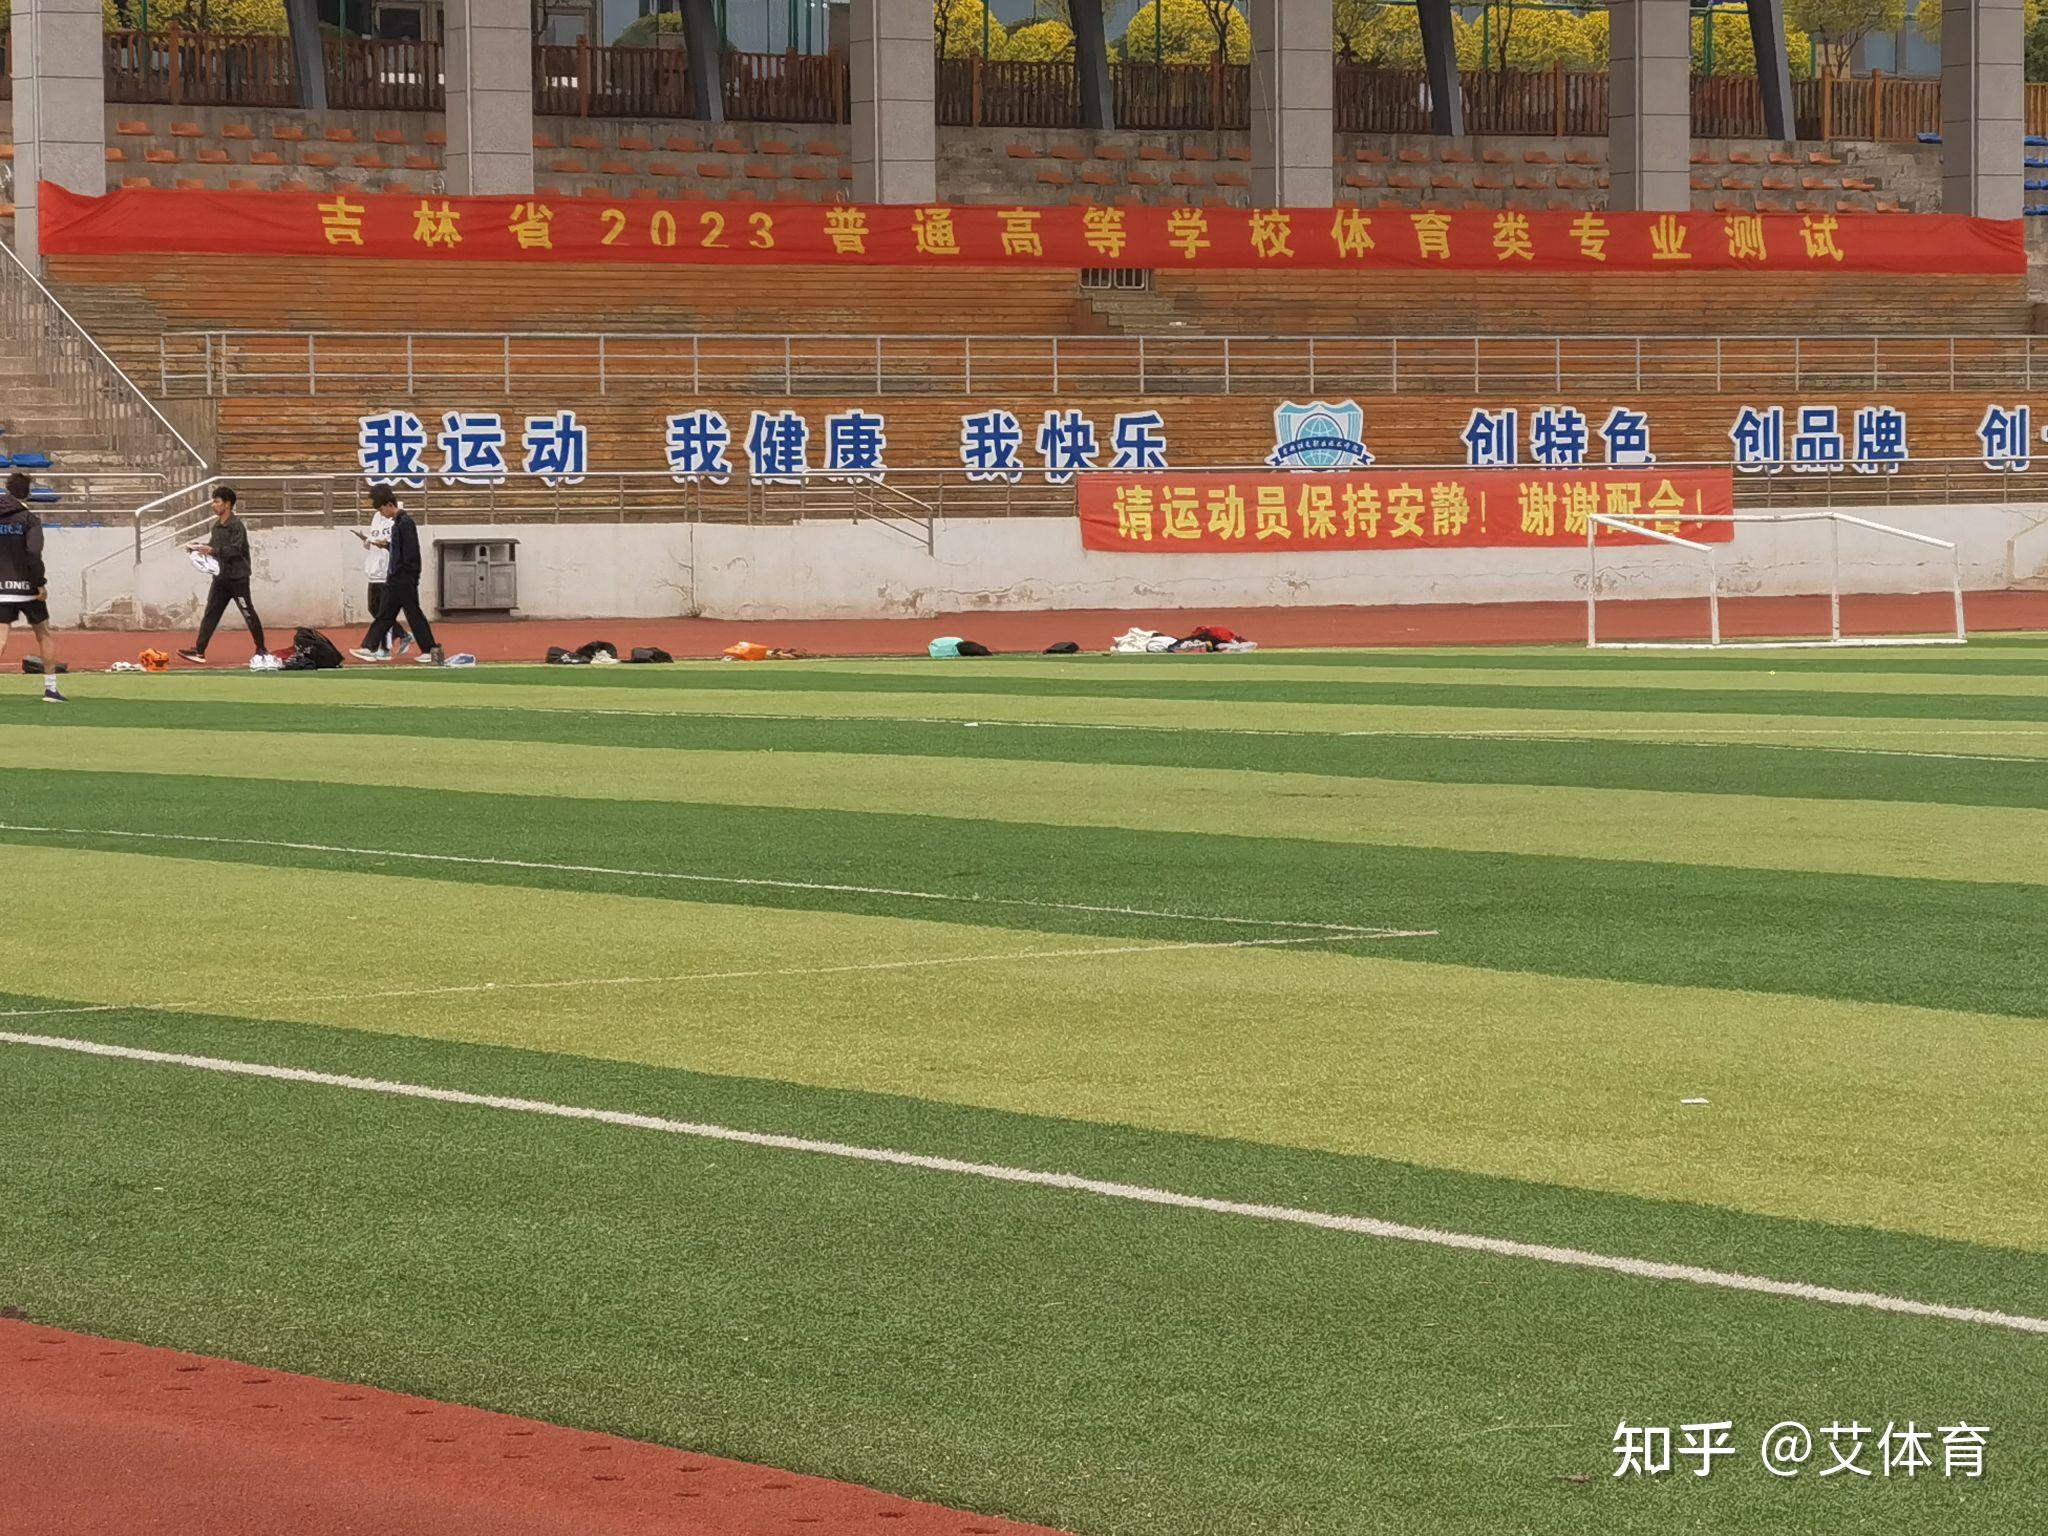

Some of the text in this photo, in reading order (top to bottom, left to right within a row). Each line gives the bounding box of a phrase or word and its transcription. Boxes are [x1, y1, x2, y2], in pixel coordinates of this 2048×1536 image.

[318, 196, 1843, 262] 吉林省2023普通高等学校体育类专业测试
[359, 410, 1168, 487] 我运动 我健康 我快乐
[1461, 405, 2048, 473] 创特色 创品牌 创
[1113, 479, 1703, 541] 请运动员保持安静！ 谢谢配合！
